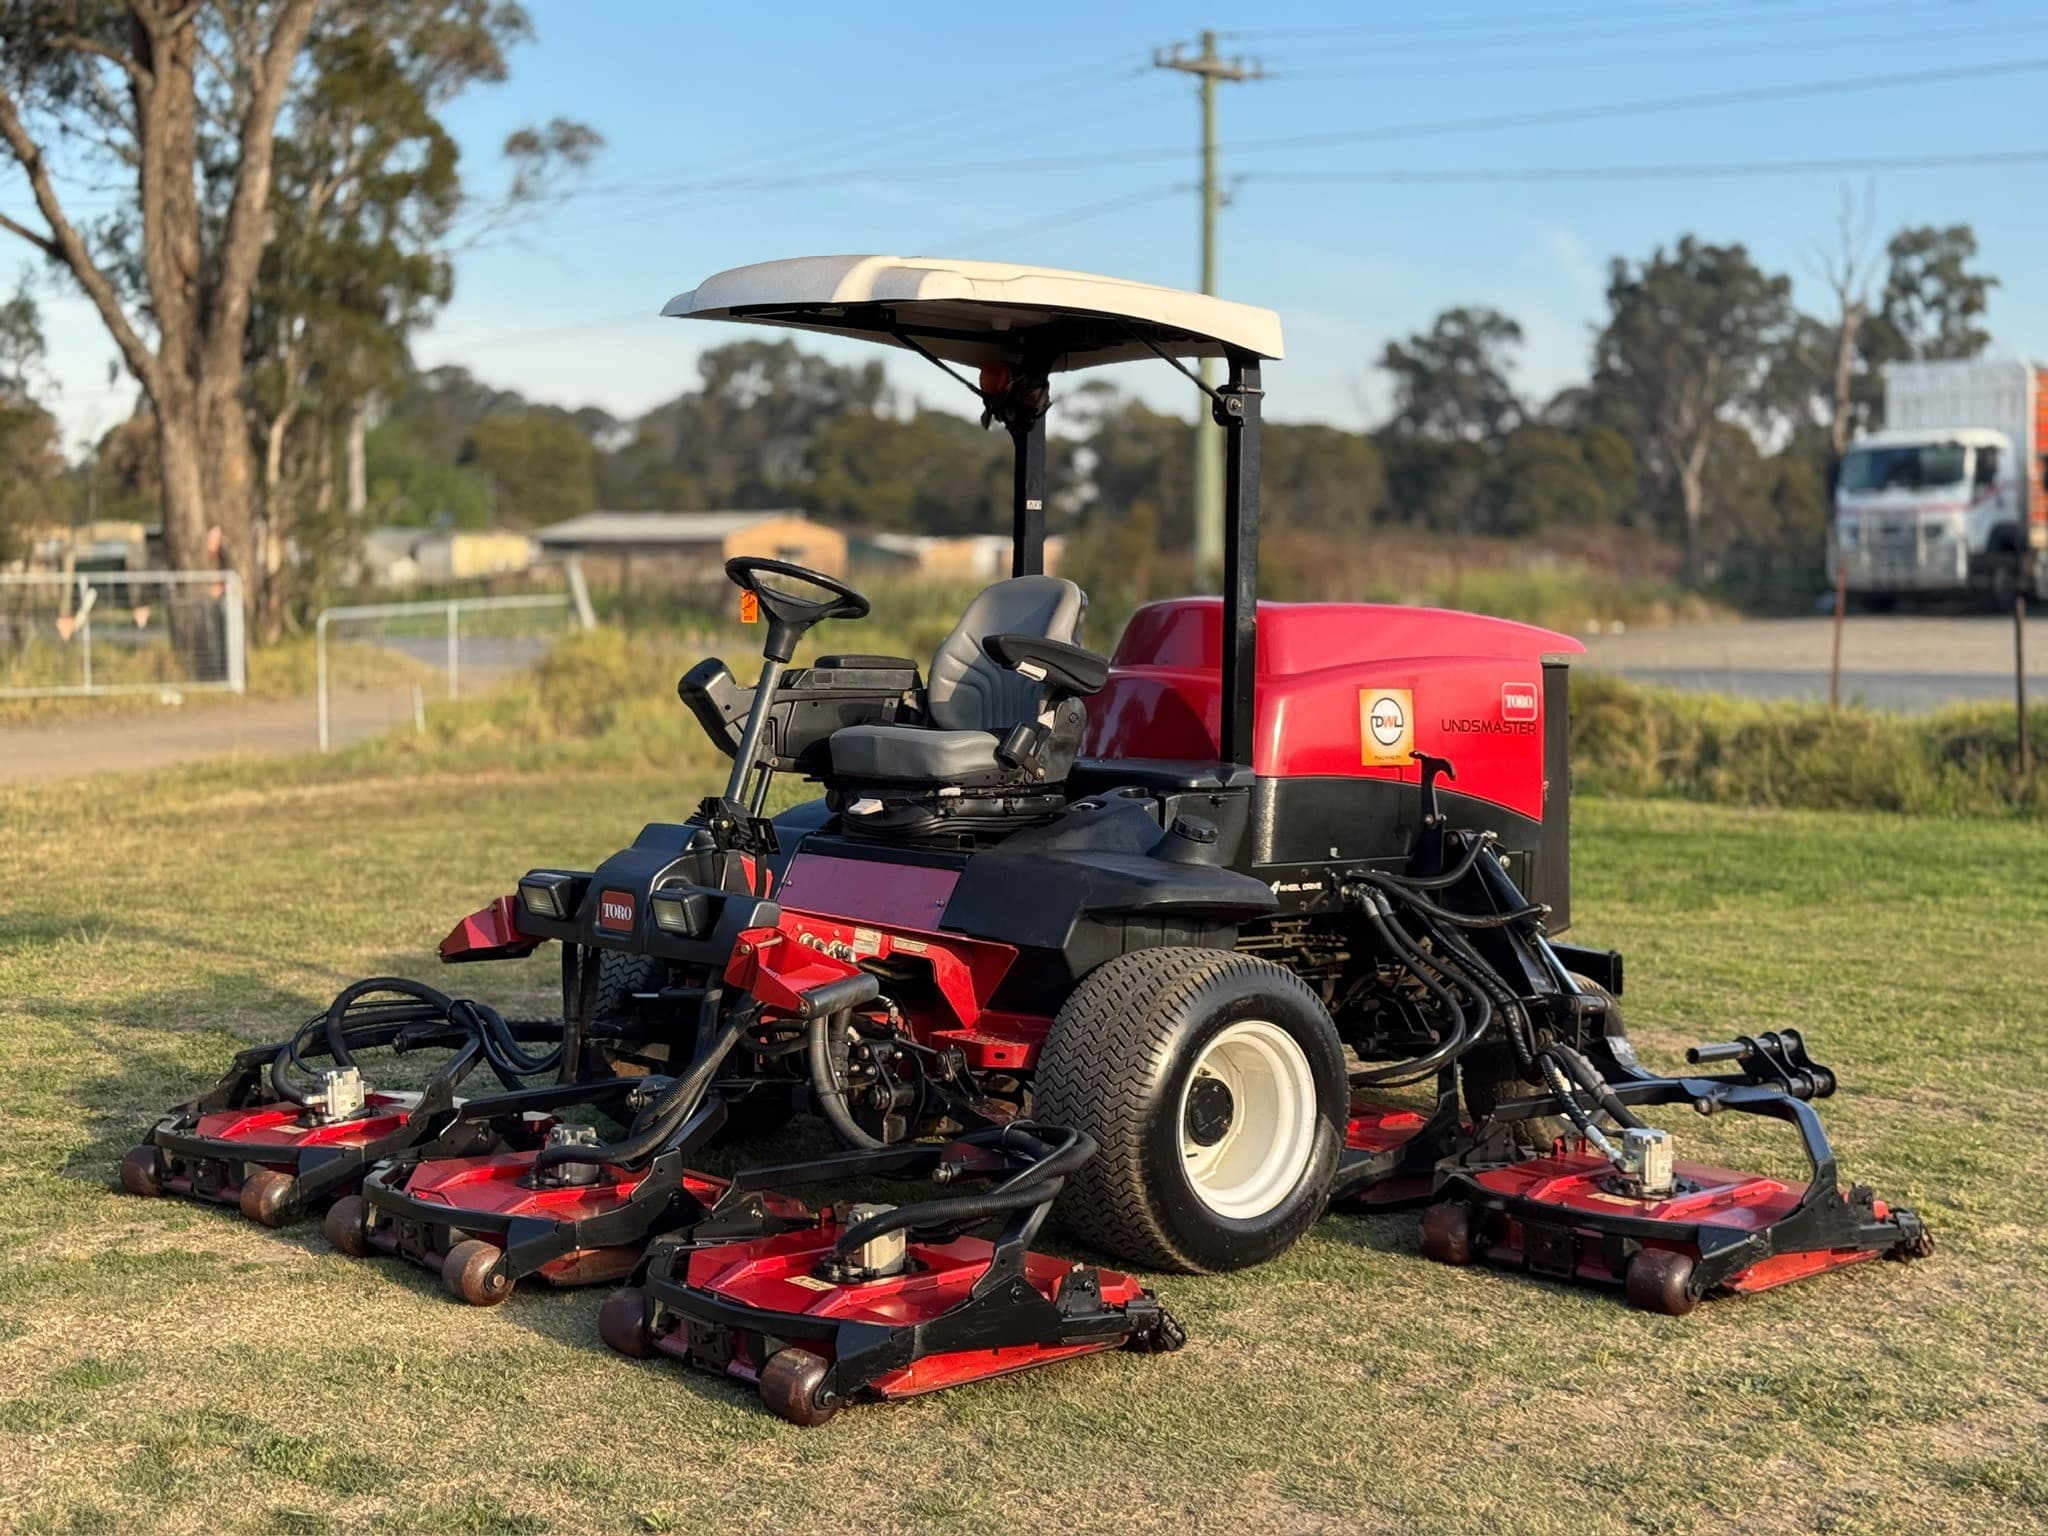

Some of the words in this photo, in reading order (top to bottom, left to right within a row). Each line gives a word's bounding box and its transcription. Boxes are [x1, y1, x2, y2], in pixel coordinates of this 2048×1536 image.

[1504, 694, 1533, 709] TORO
[1441, 719, 1537, 735] UNDSMASTER
[602, 902, 632, 921] TORO
